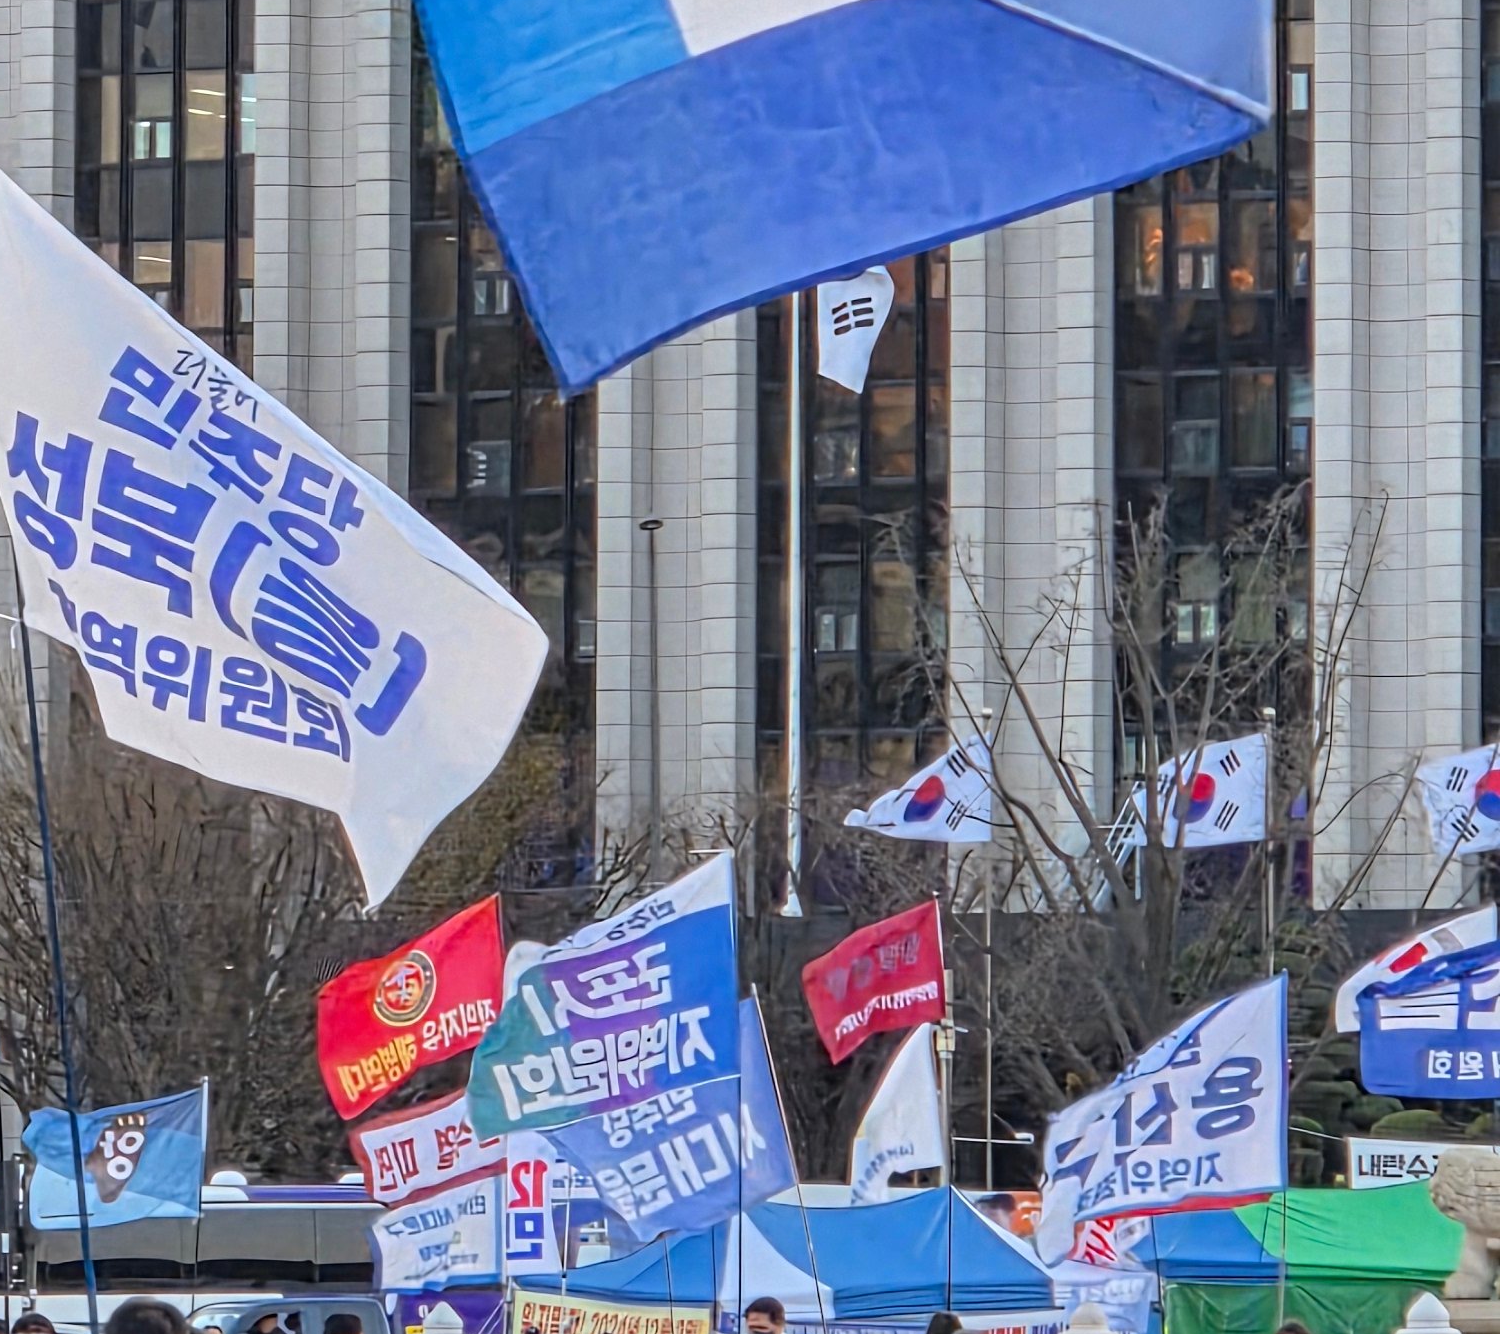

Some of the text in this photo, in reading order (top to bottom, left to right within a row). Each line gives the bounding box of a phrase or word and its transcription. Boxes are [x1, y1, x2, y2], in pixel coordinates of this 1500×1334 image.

[99, 346, 365, 567] 민주당
[7, 411, 427, 736] 성북(을)
[1358, 1154, 1438, 1179] 내란수
